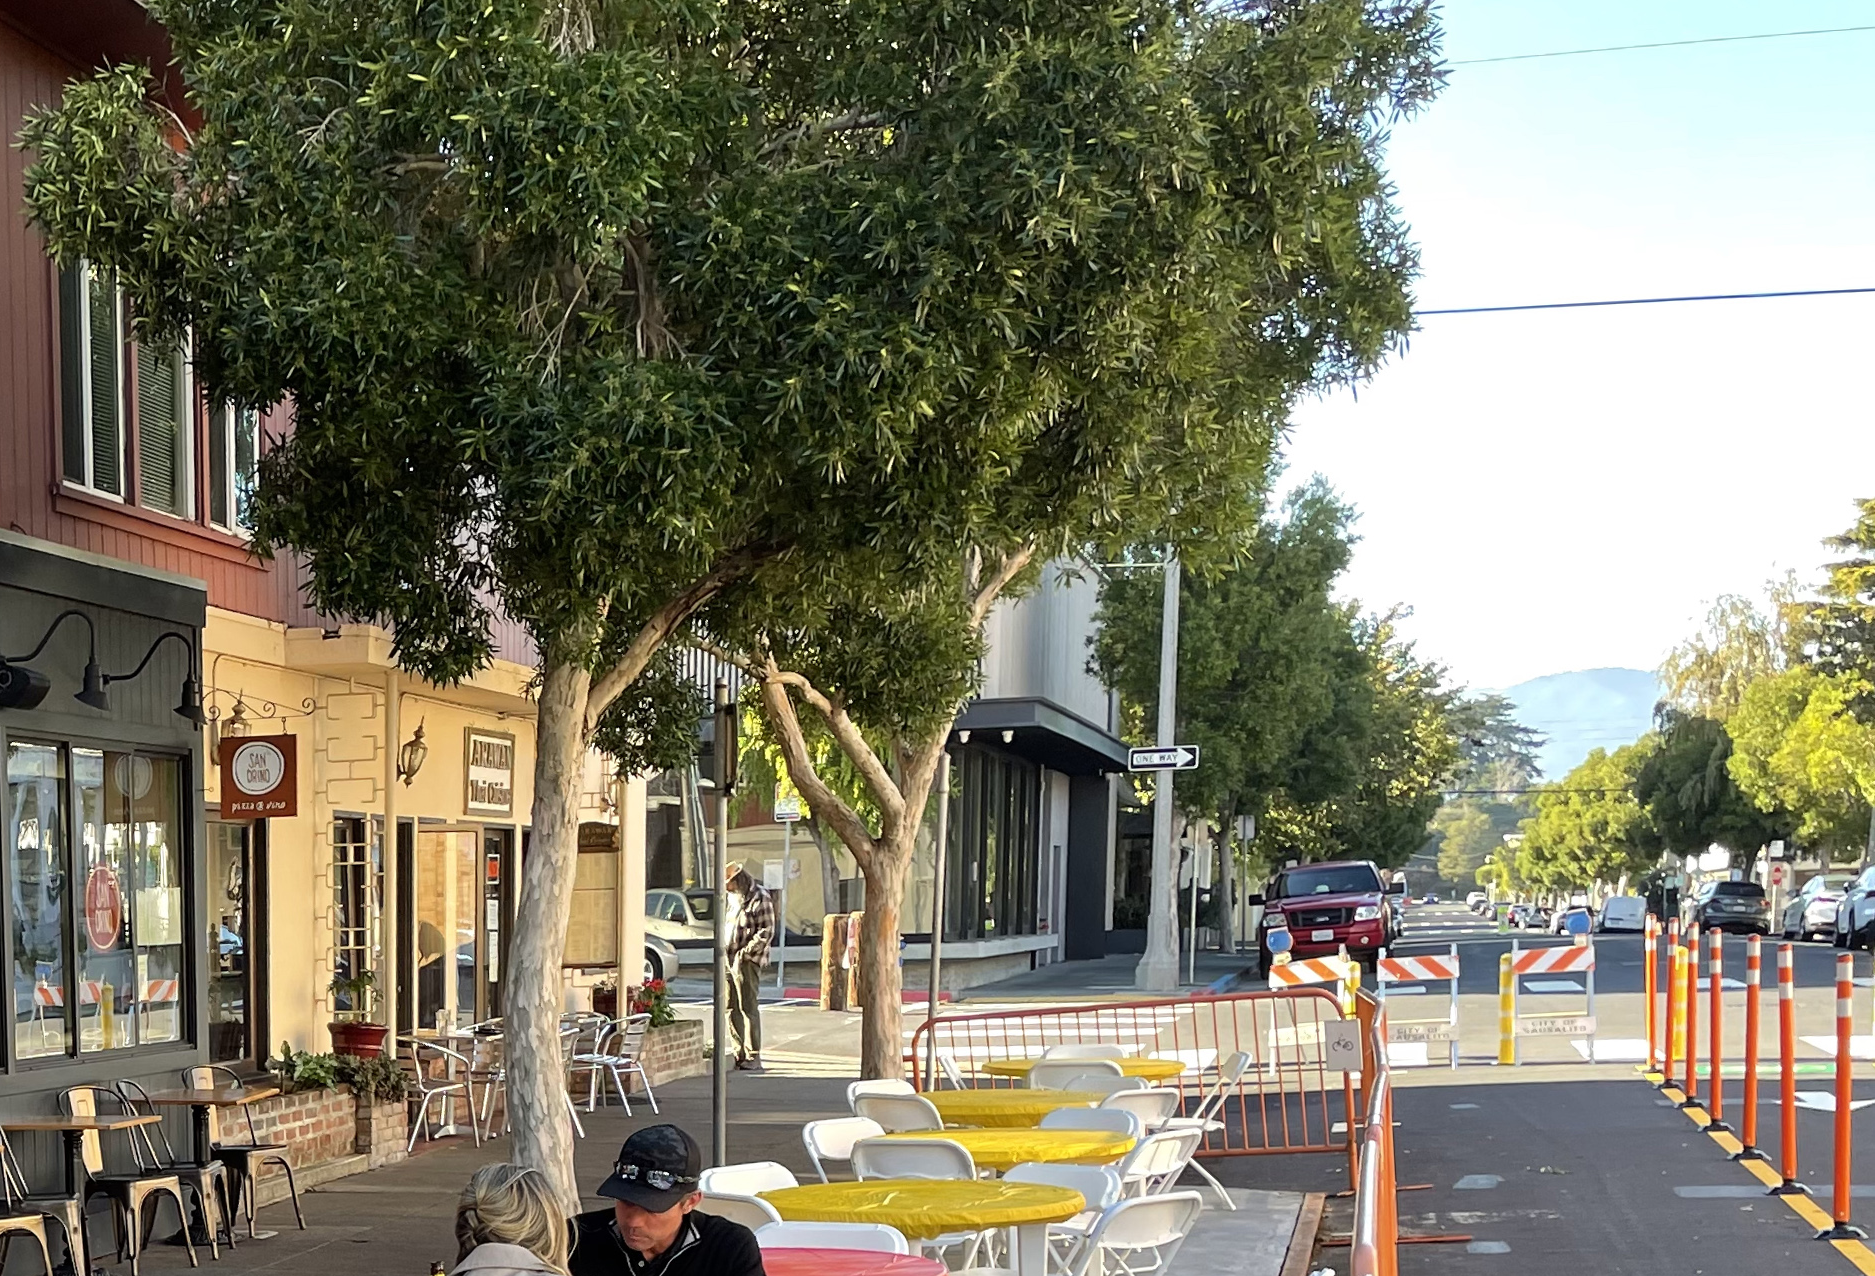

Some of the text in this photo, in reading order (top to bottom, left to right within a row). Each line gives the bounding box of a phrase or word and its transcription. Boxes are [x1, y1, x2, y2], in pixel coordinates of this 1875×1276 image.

[248, 752, 266, 768] SAN
[1135, 753, 1178, 763] ONE WAY
